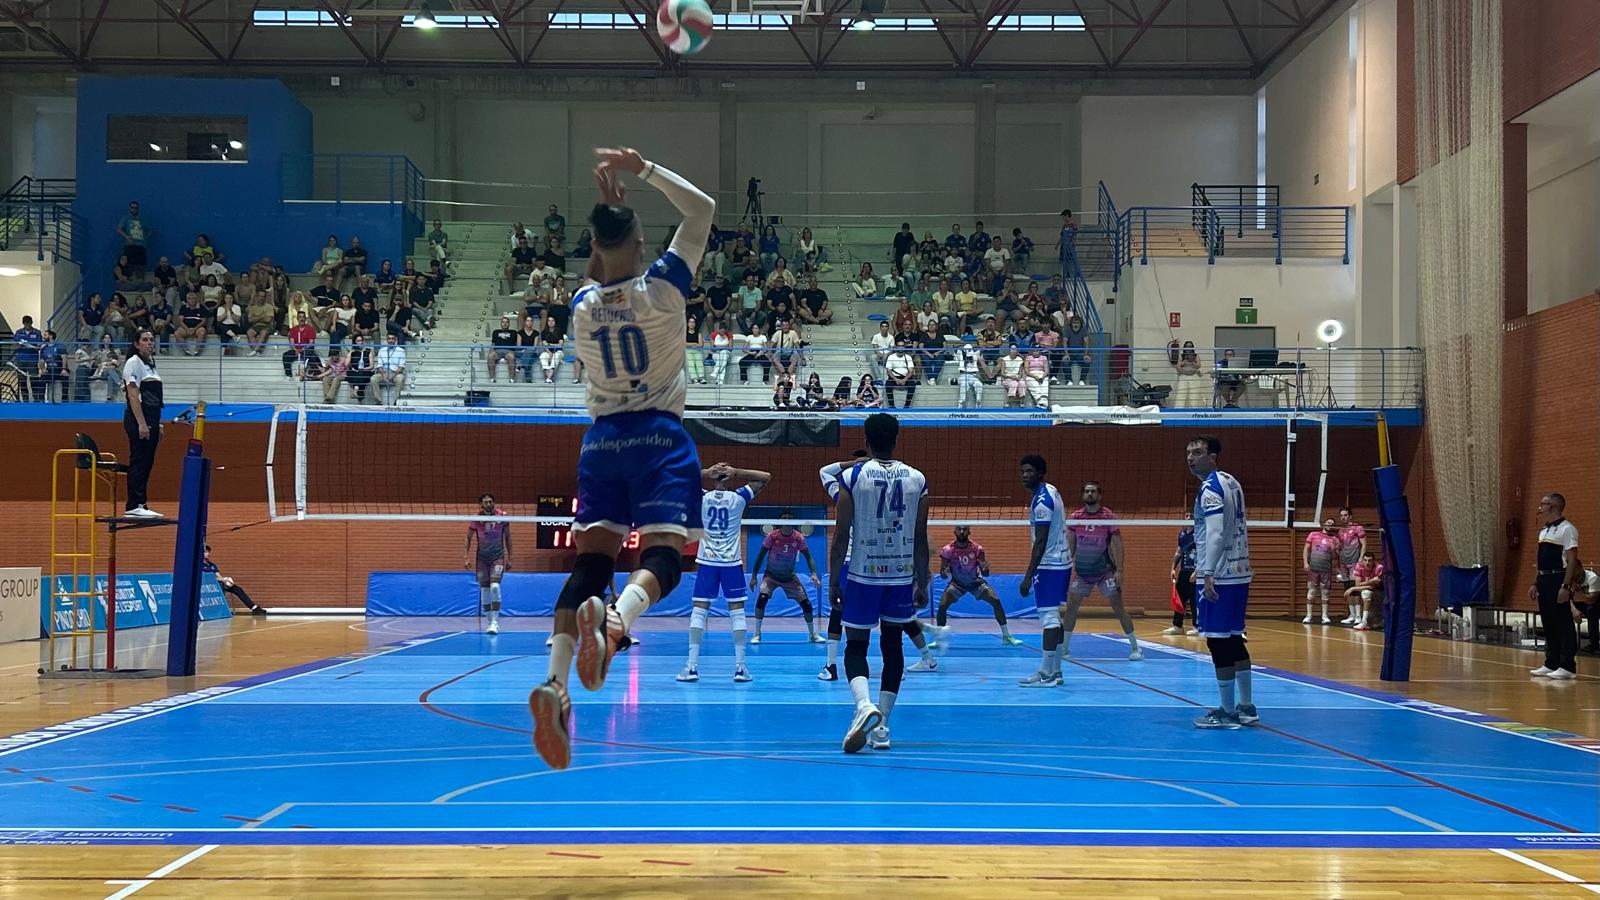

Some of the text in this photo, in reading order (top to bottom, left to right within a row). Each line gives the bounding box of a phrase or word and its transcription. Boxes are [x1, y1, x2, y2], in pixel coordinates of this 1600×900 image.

[590, 323, 650, 379] 10
[874, 479, 906, 518] 74
[553, 530, 571, 547] 11
[1, 579, 39, 599] GROUP
[1105, 578, 1116, 588] 13
